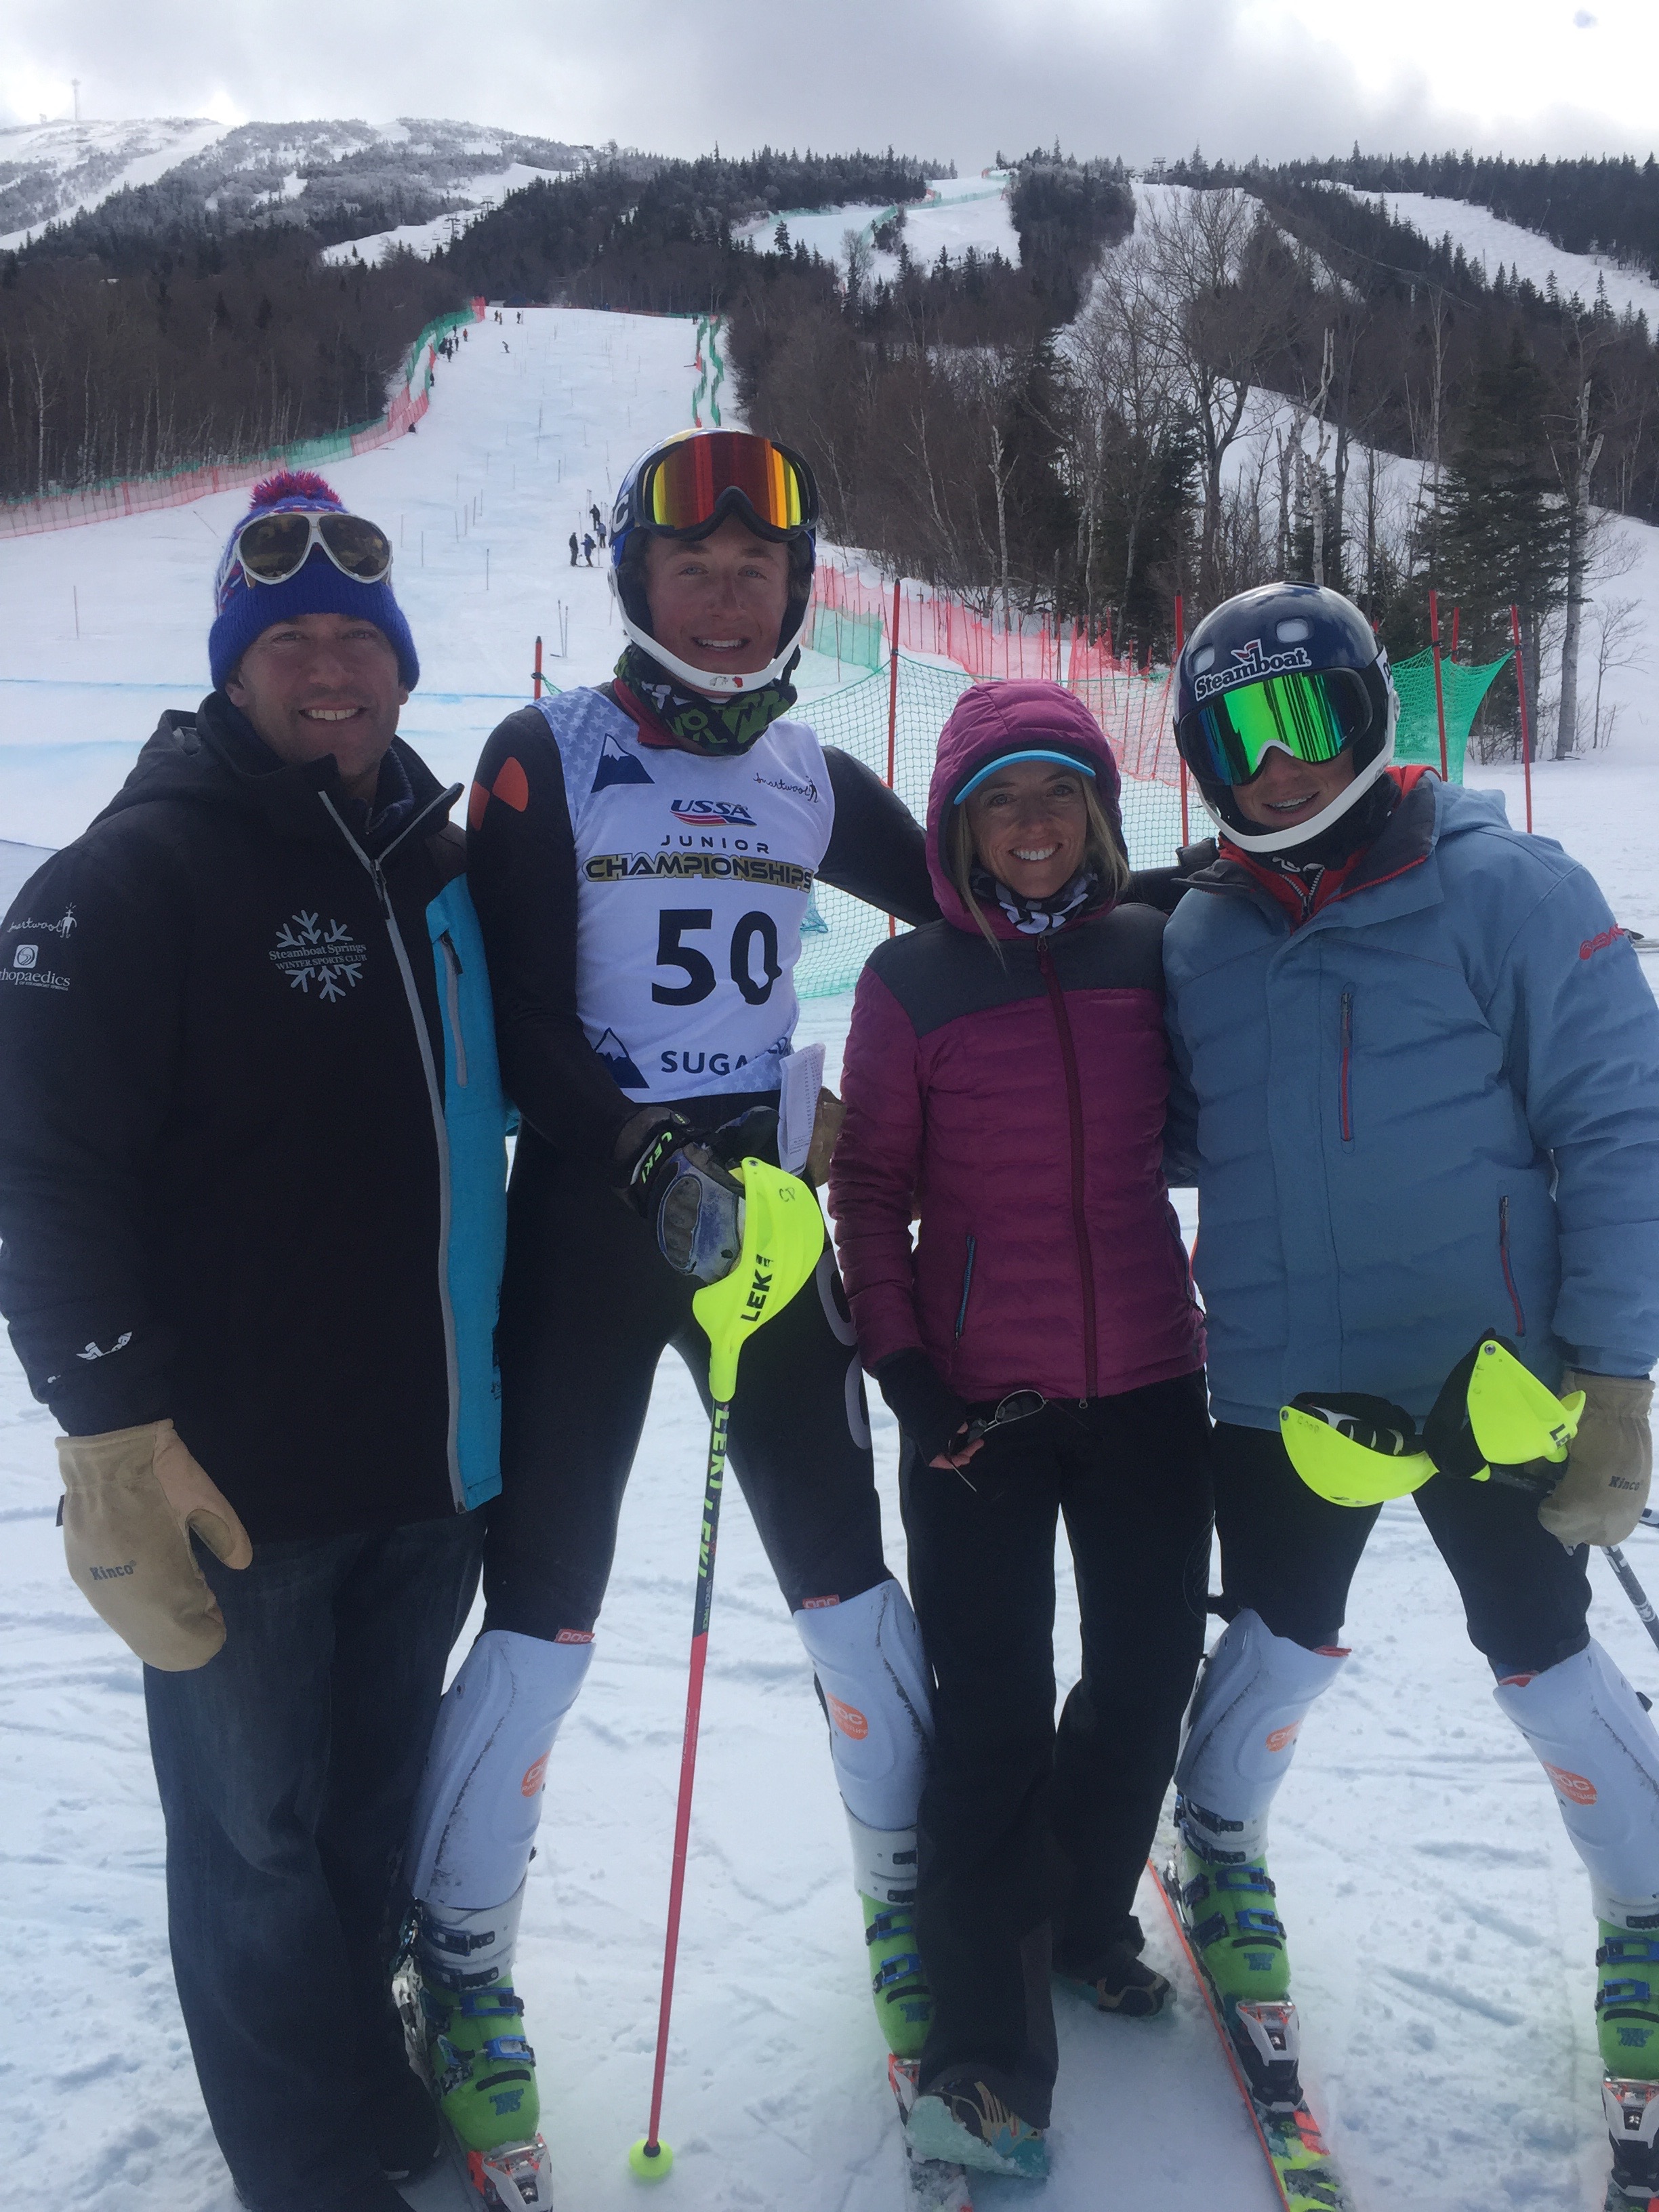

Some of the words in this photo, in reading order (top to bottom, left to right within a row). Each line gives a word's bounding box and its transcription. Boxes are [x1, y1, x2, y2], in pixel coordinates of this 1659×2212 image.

[1195, 639, 1310, 701] Steamboat
[670, 798, 753, 819] USSA
[660, 834, 770, 855] JUNIOR
[584, 853, 813, 891] CHAMPIONSHIPS
[268, 946, 327, 961] Steamboat
[327, 942, 367, 956] Springs
[275, 959, 312, 970] WINTER
[312, 956, 344, 966] SPORTS
[345, 954, 367, 962] CLUB
[651, 908, 783, 1006] 50
[661, 1050, 758, 1076] SUGA
[1549, 1423, 1571, 1448] LE
[89, 1565, 134, 1580] Kinco
